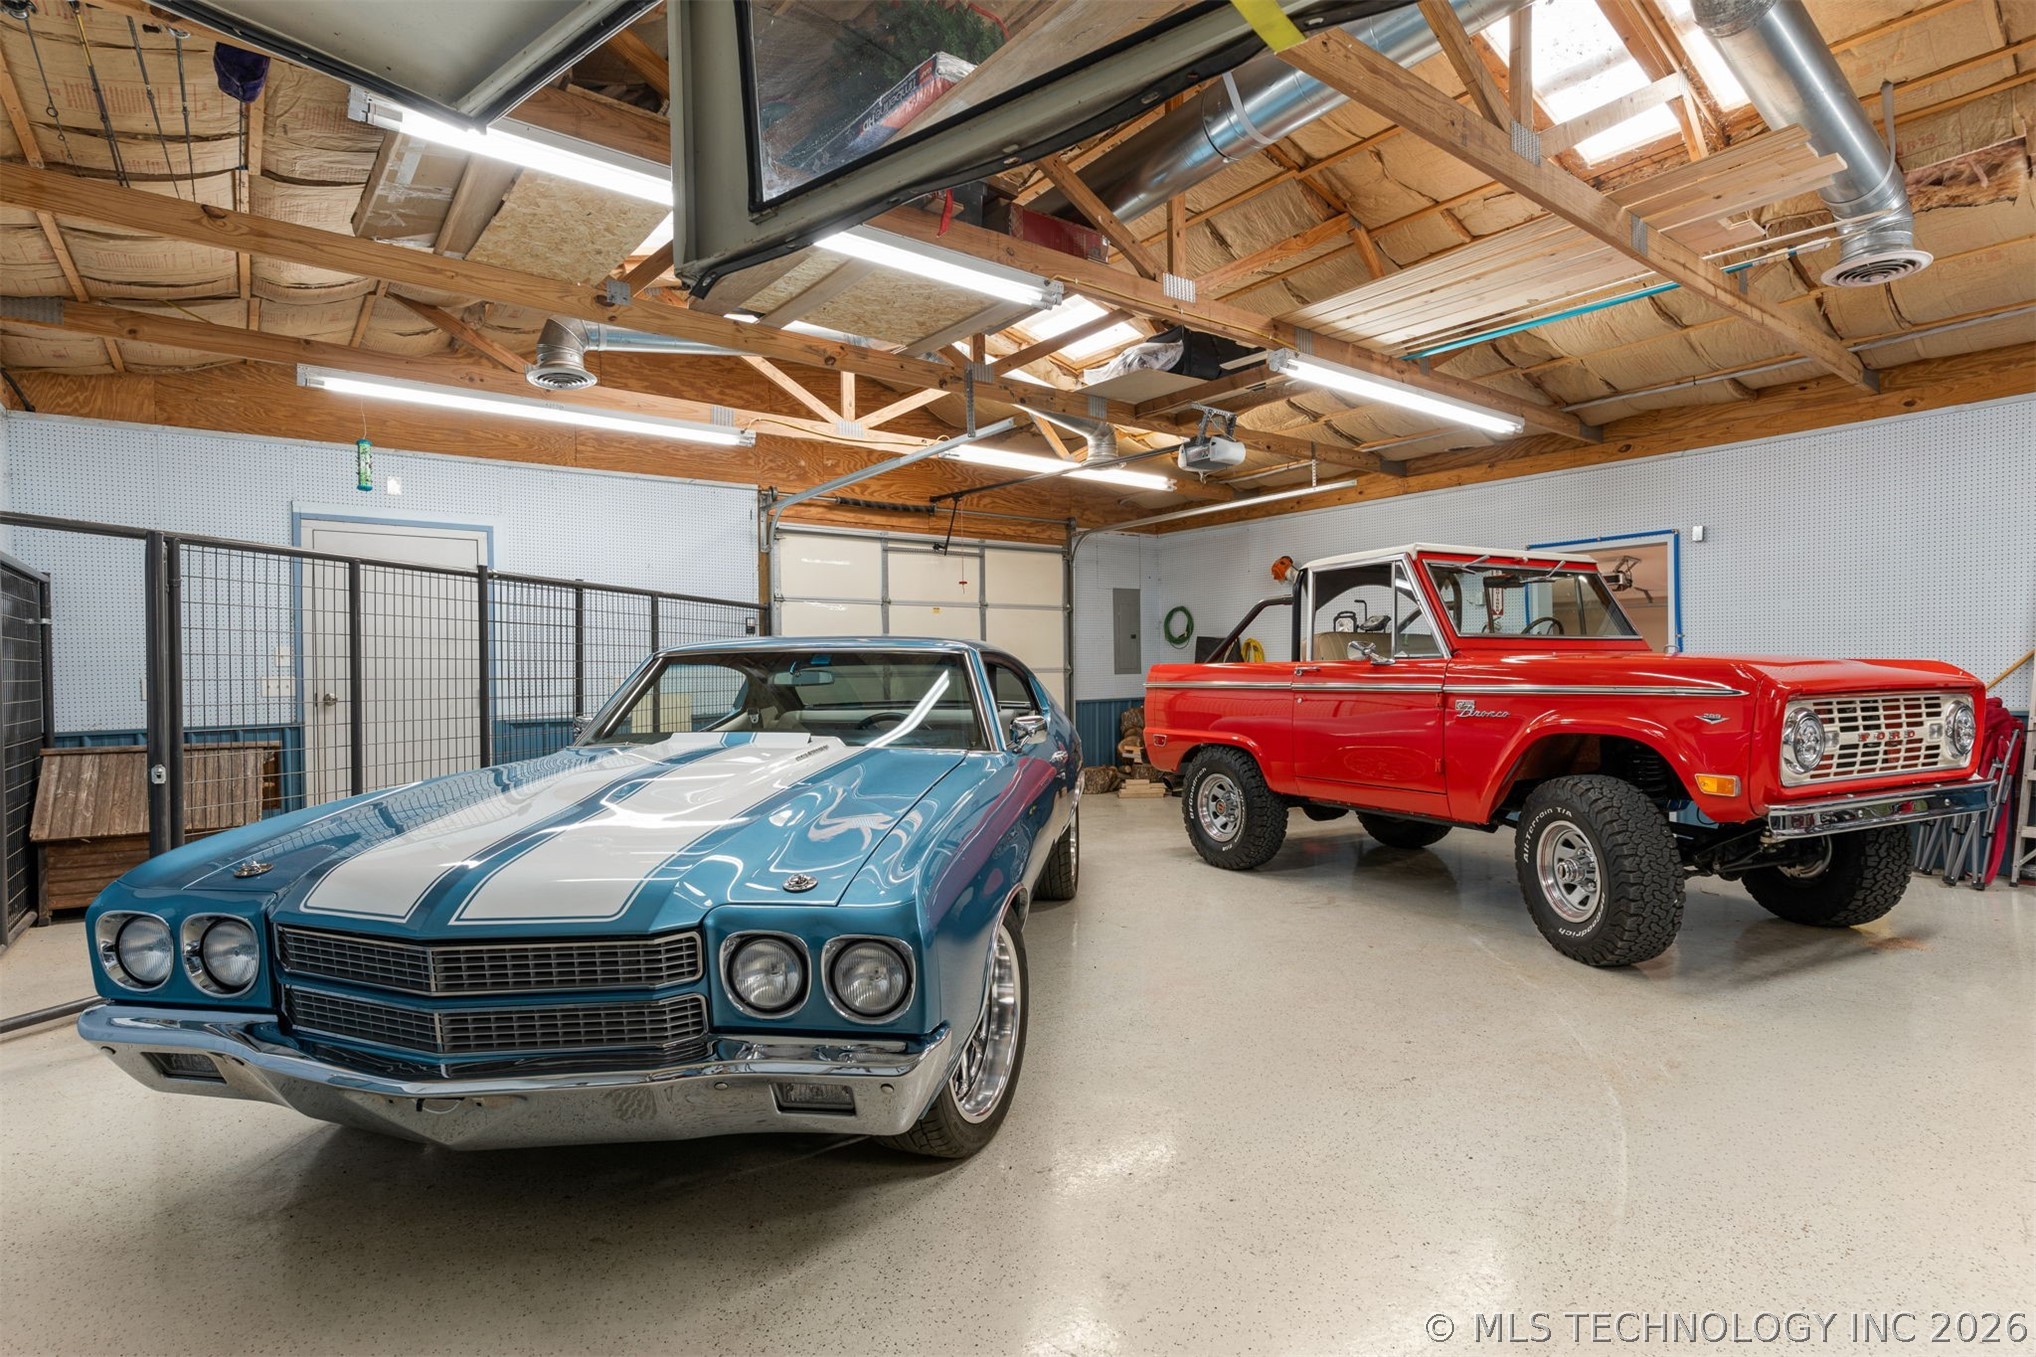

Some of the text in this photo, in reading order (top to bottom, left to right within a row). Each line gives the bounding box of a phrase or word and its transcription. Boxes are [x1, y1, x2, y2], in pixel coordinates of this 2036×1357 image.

[1457, 704, 1511, 717] Bronco
[1858, 729, 1916, 742] FORD
[1523, 806, 1573, 863] All-Terrain T/A
